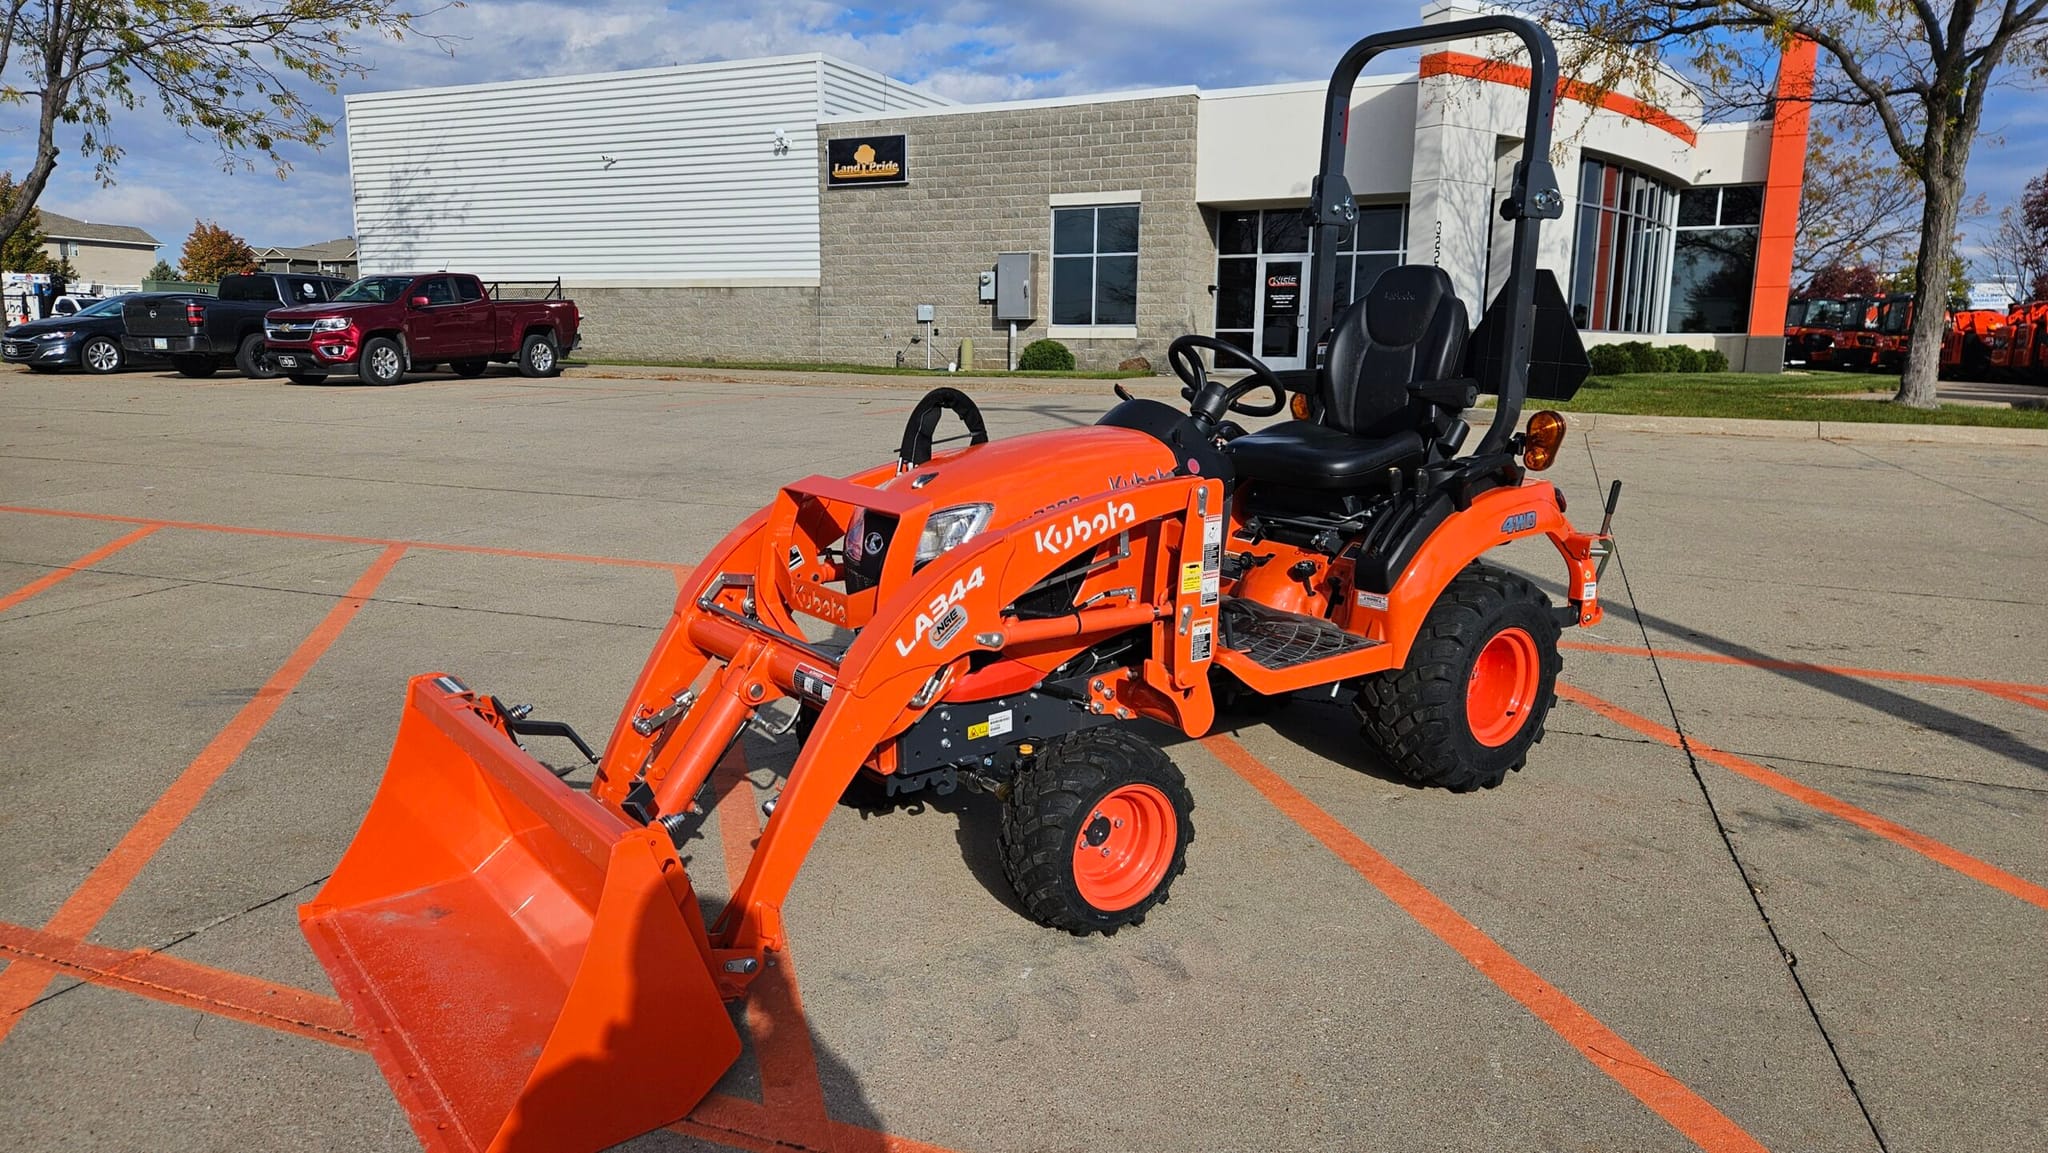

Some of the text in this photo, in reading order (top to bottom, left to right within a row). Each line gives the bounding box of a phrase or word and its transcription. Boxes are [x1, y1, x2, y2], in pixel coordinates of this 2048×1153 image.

[834, 160, 899, 173] Land Pride
[1034, 501, 1136, 554] Kubota
[1501, 511, 1536, 534] 4WD
[791, 583, 846, 623] Kubota
[895, 566, 985, 656] LA344
[936, 608, 959, 634] NGE
